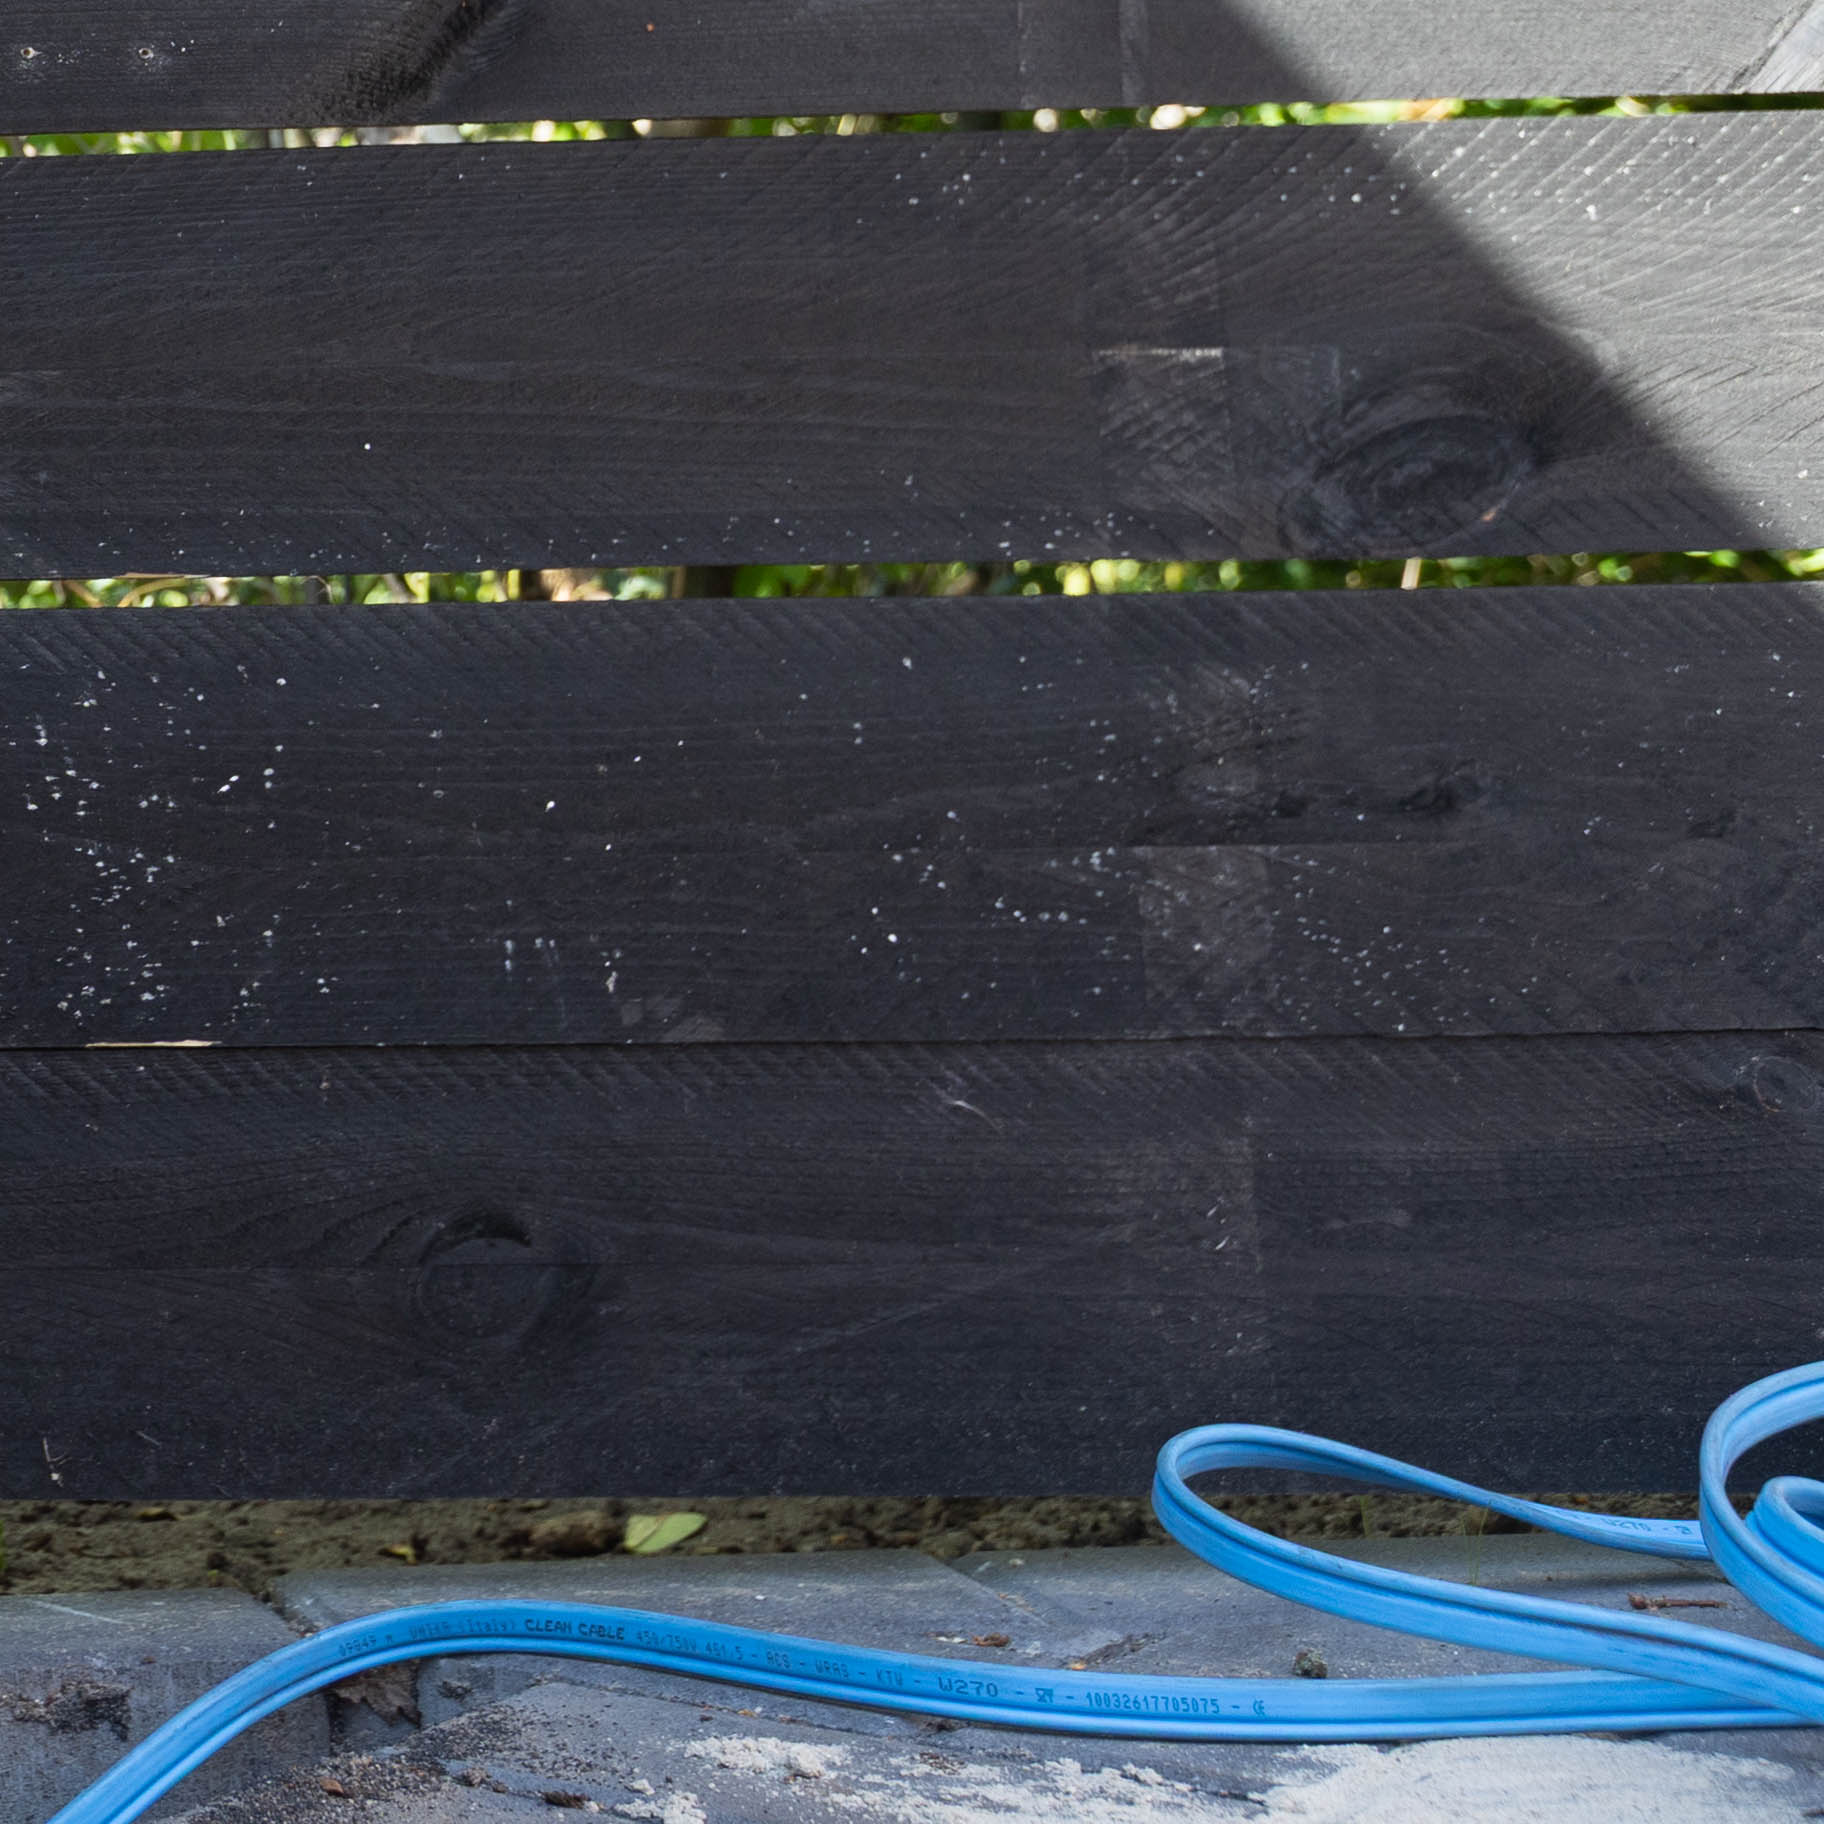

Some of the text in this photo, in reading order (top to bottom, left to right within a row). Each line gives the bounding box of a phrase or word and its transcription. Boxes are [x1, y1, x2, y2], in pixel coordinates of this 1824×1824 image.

[524, 1618, 573, 1634] CLEAN
[578, 1622, 626, 1641] CABLE
[767, 1651, 792, 1669] ACS
[815, 1659, 850, 1680] WRAS
[937, 1676, 999, 1699] W270
